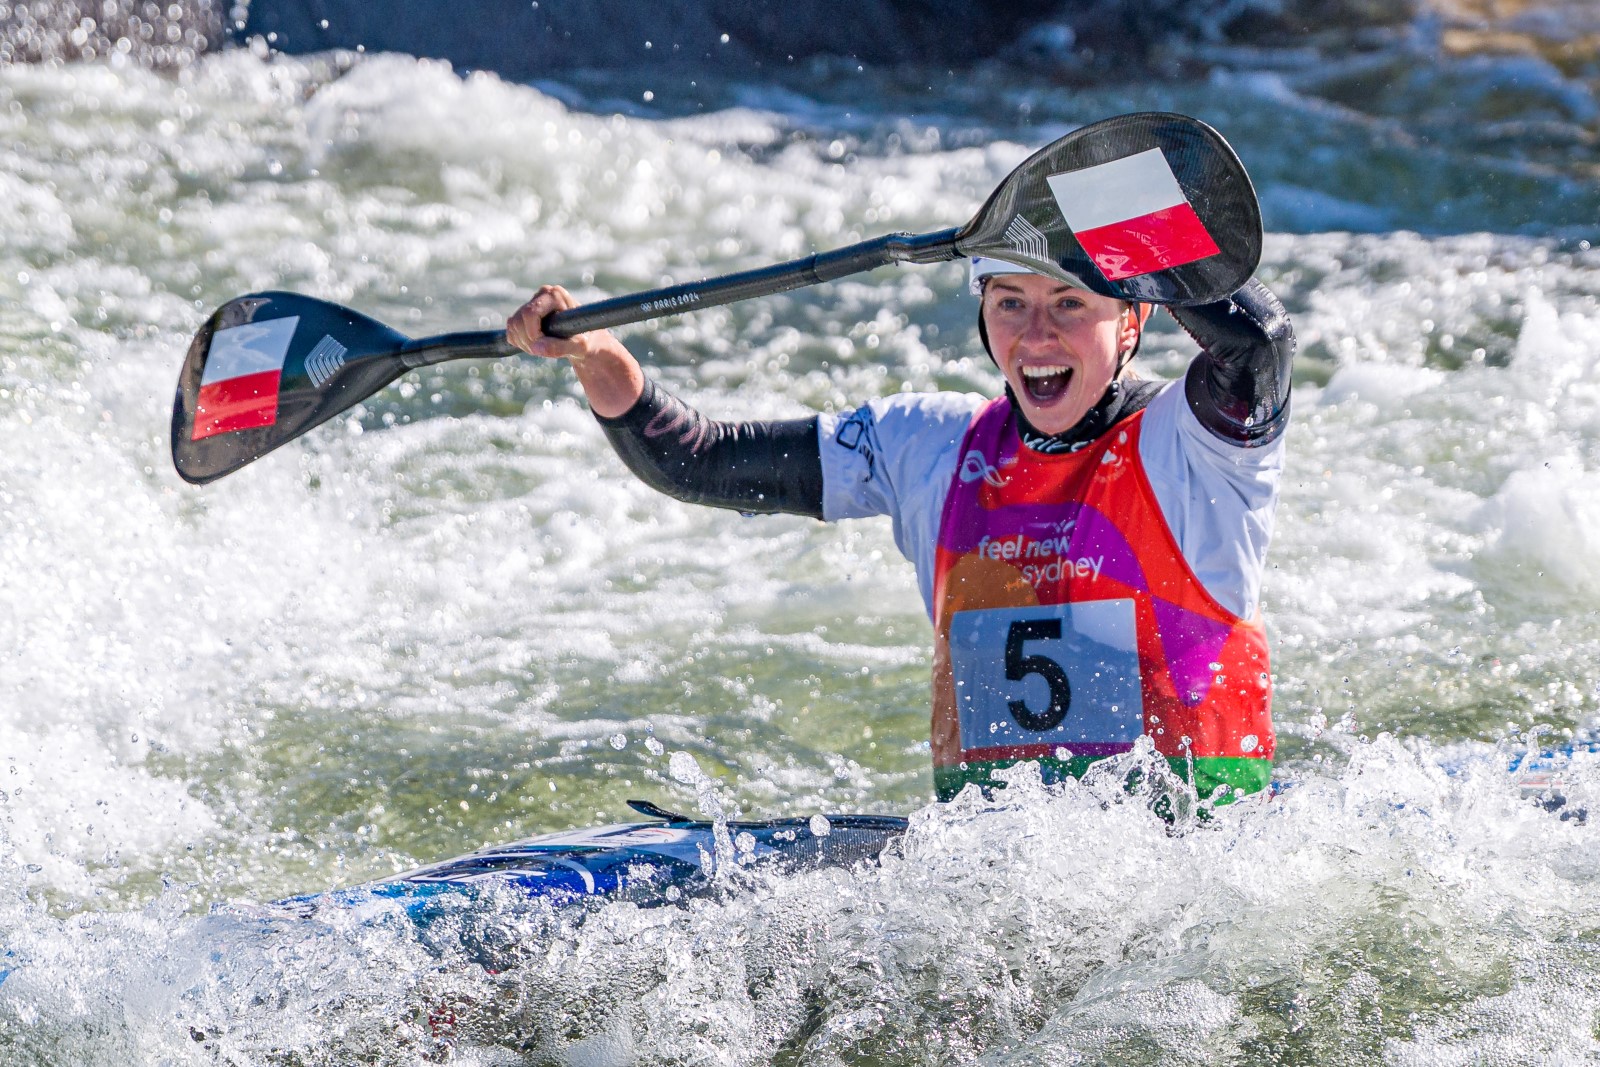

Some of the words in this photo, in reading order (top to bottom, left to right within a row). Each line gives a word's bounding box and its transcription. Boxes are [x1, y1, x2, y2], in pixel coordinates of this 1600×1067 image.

[653, 297, 677, 309] PARIS
[677, 292, 700, 304] 2024
[978, 535, 1023, 560] feel
[1025, 536, 1071, 558] new
[1022, 555, 1104, 589] sydney
[1005, 618, 1071, 732] 5
